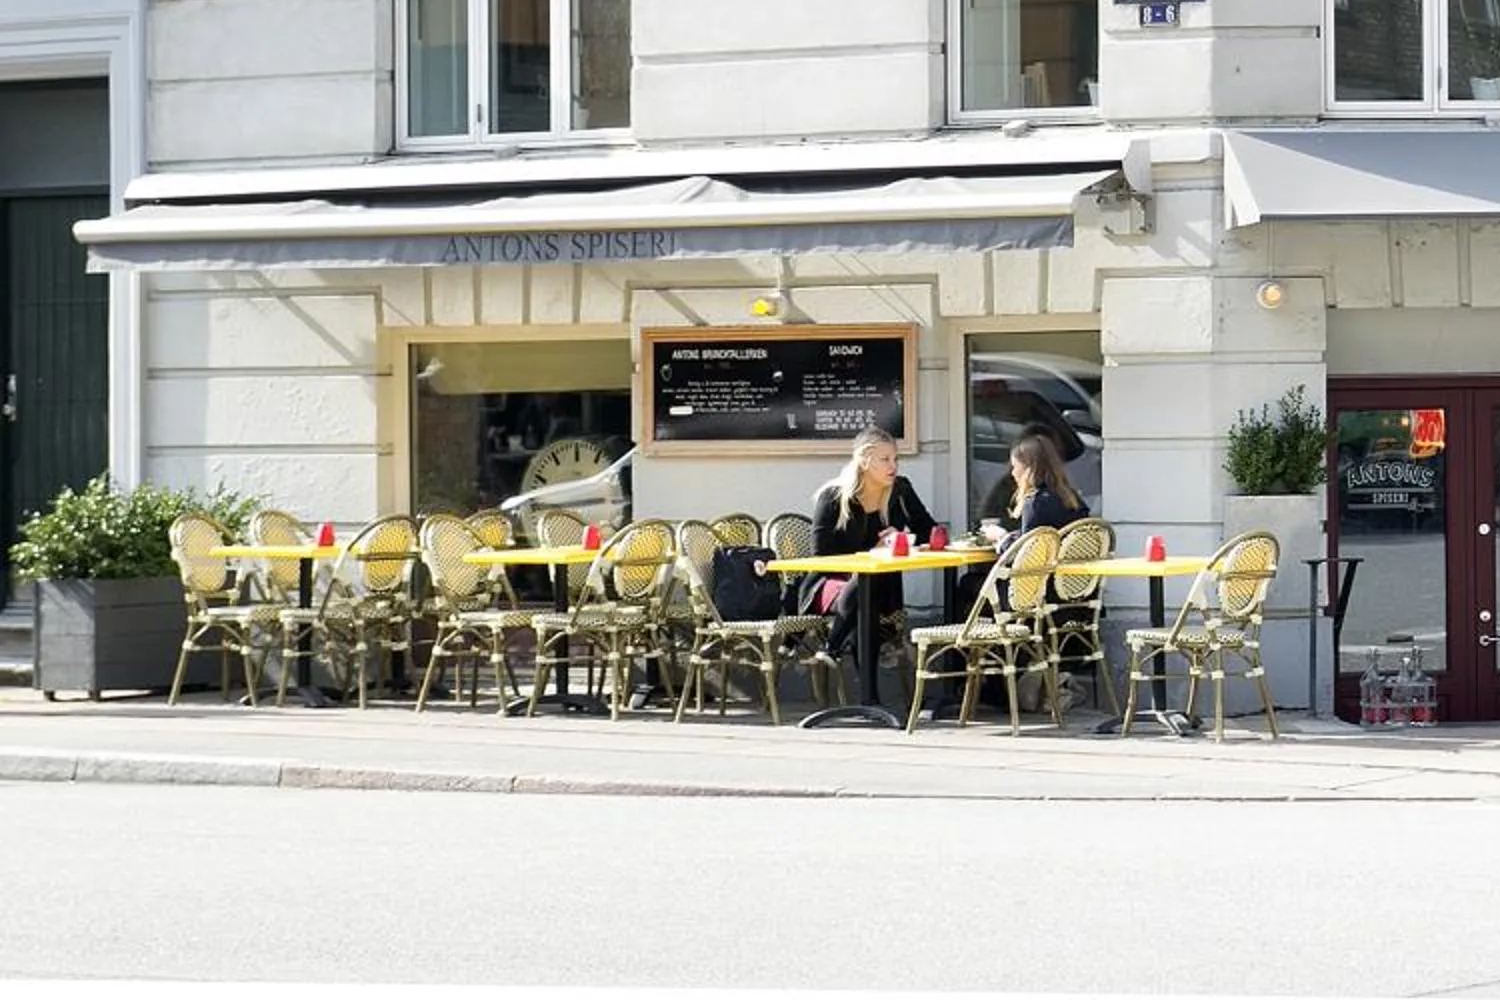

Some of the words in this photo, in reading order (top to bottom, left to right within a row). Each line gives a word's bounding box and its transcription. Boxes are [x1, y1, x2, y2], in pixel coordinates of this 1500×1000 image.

[442, 233, 560, 263] ANTONS
[570, 231, 676, 260] SPISERI
[1347, 461, 1436, 489] ANTONS
[1373, 492, 1409, 504] SPISERI
